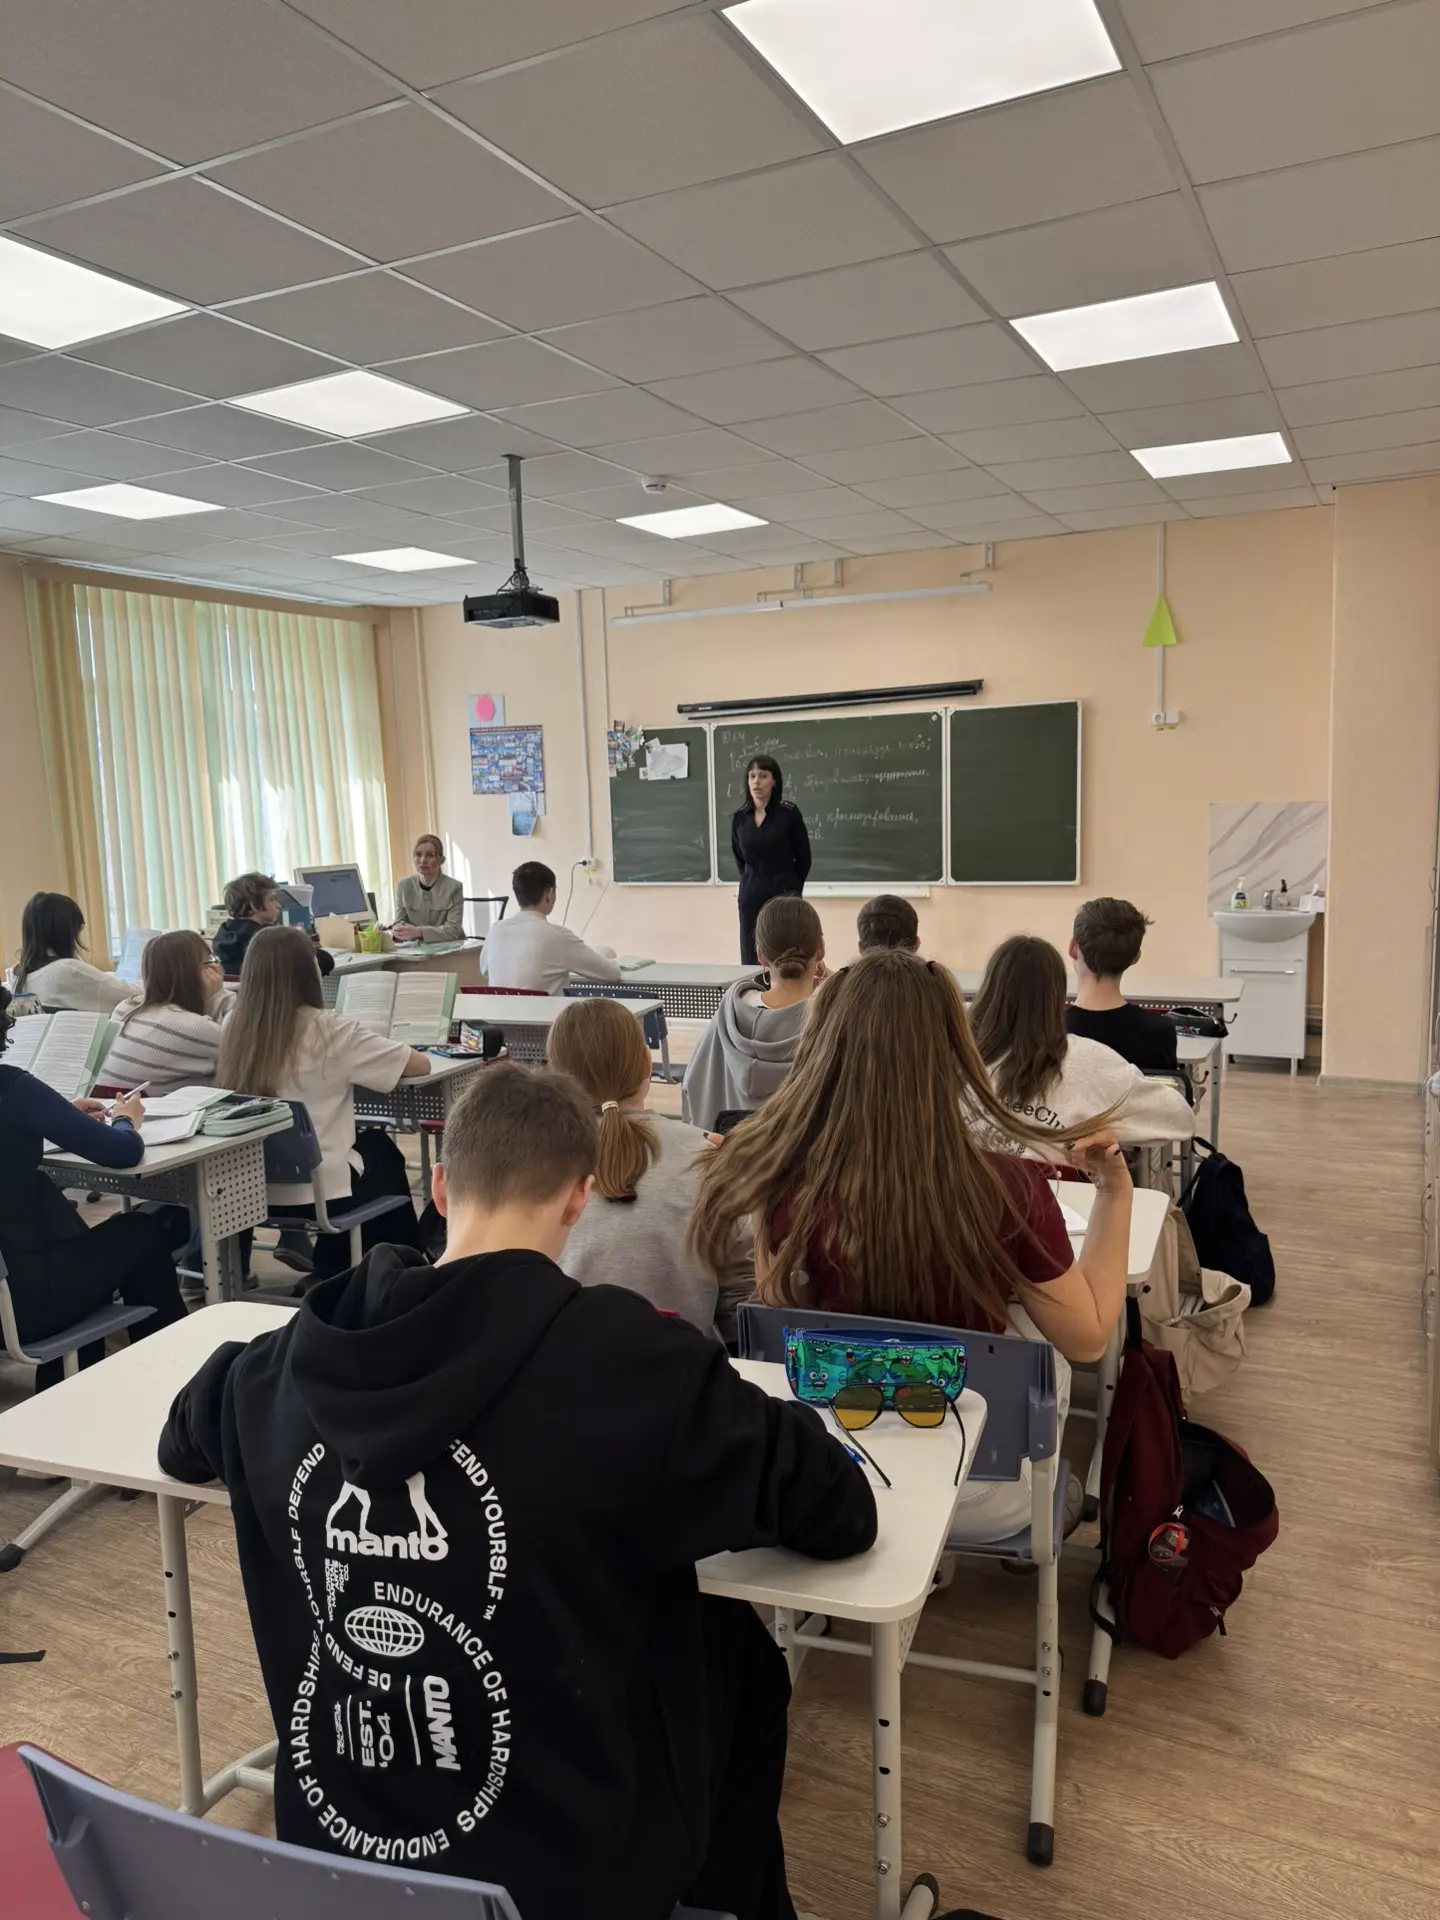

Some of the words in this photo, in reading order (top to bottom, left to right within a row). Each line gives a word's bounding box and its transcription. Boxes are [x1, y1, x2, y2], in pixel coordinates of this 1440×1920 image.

[288, 1442, 326, 1521] DEFEND
[326, 1528, 449, 1561] manto
[480, 1486, 508, 1601] YOURSLF
[374, 1581, 494, 1670] ENDURANCE
[483, 1671, 507, 1702] OF
[359, 1700, 375, 1767] EST.
[299, 1774, 324, 1807] OF
[457, 1708, 511, 1832] HARDSHIPS
[318, 1803, 450, 1861] ENDURANCE
